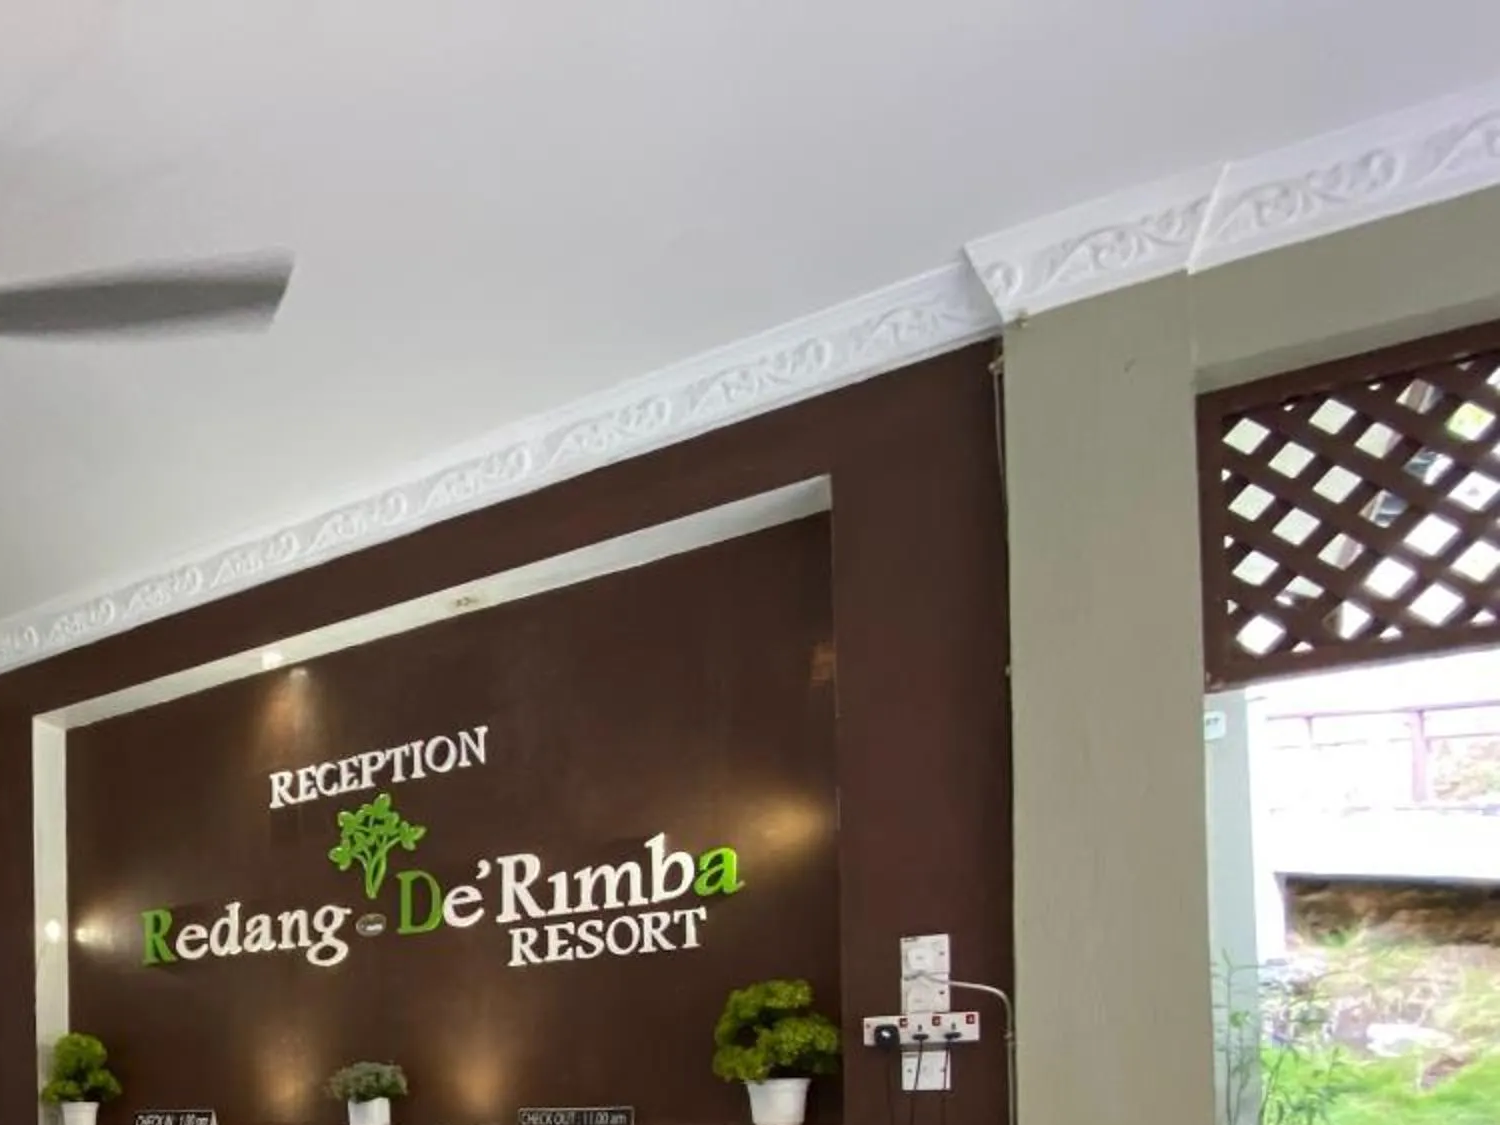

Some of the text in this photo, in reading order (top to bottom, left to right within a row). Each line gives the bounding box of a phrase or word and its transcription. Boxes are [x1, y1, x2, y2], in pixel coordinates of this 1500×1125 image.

[269, 725, 488, 808] RECEPTION
[142, 901, 352, 967] Redang
[508, 907, 707, 967] RESORT
